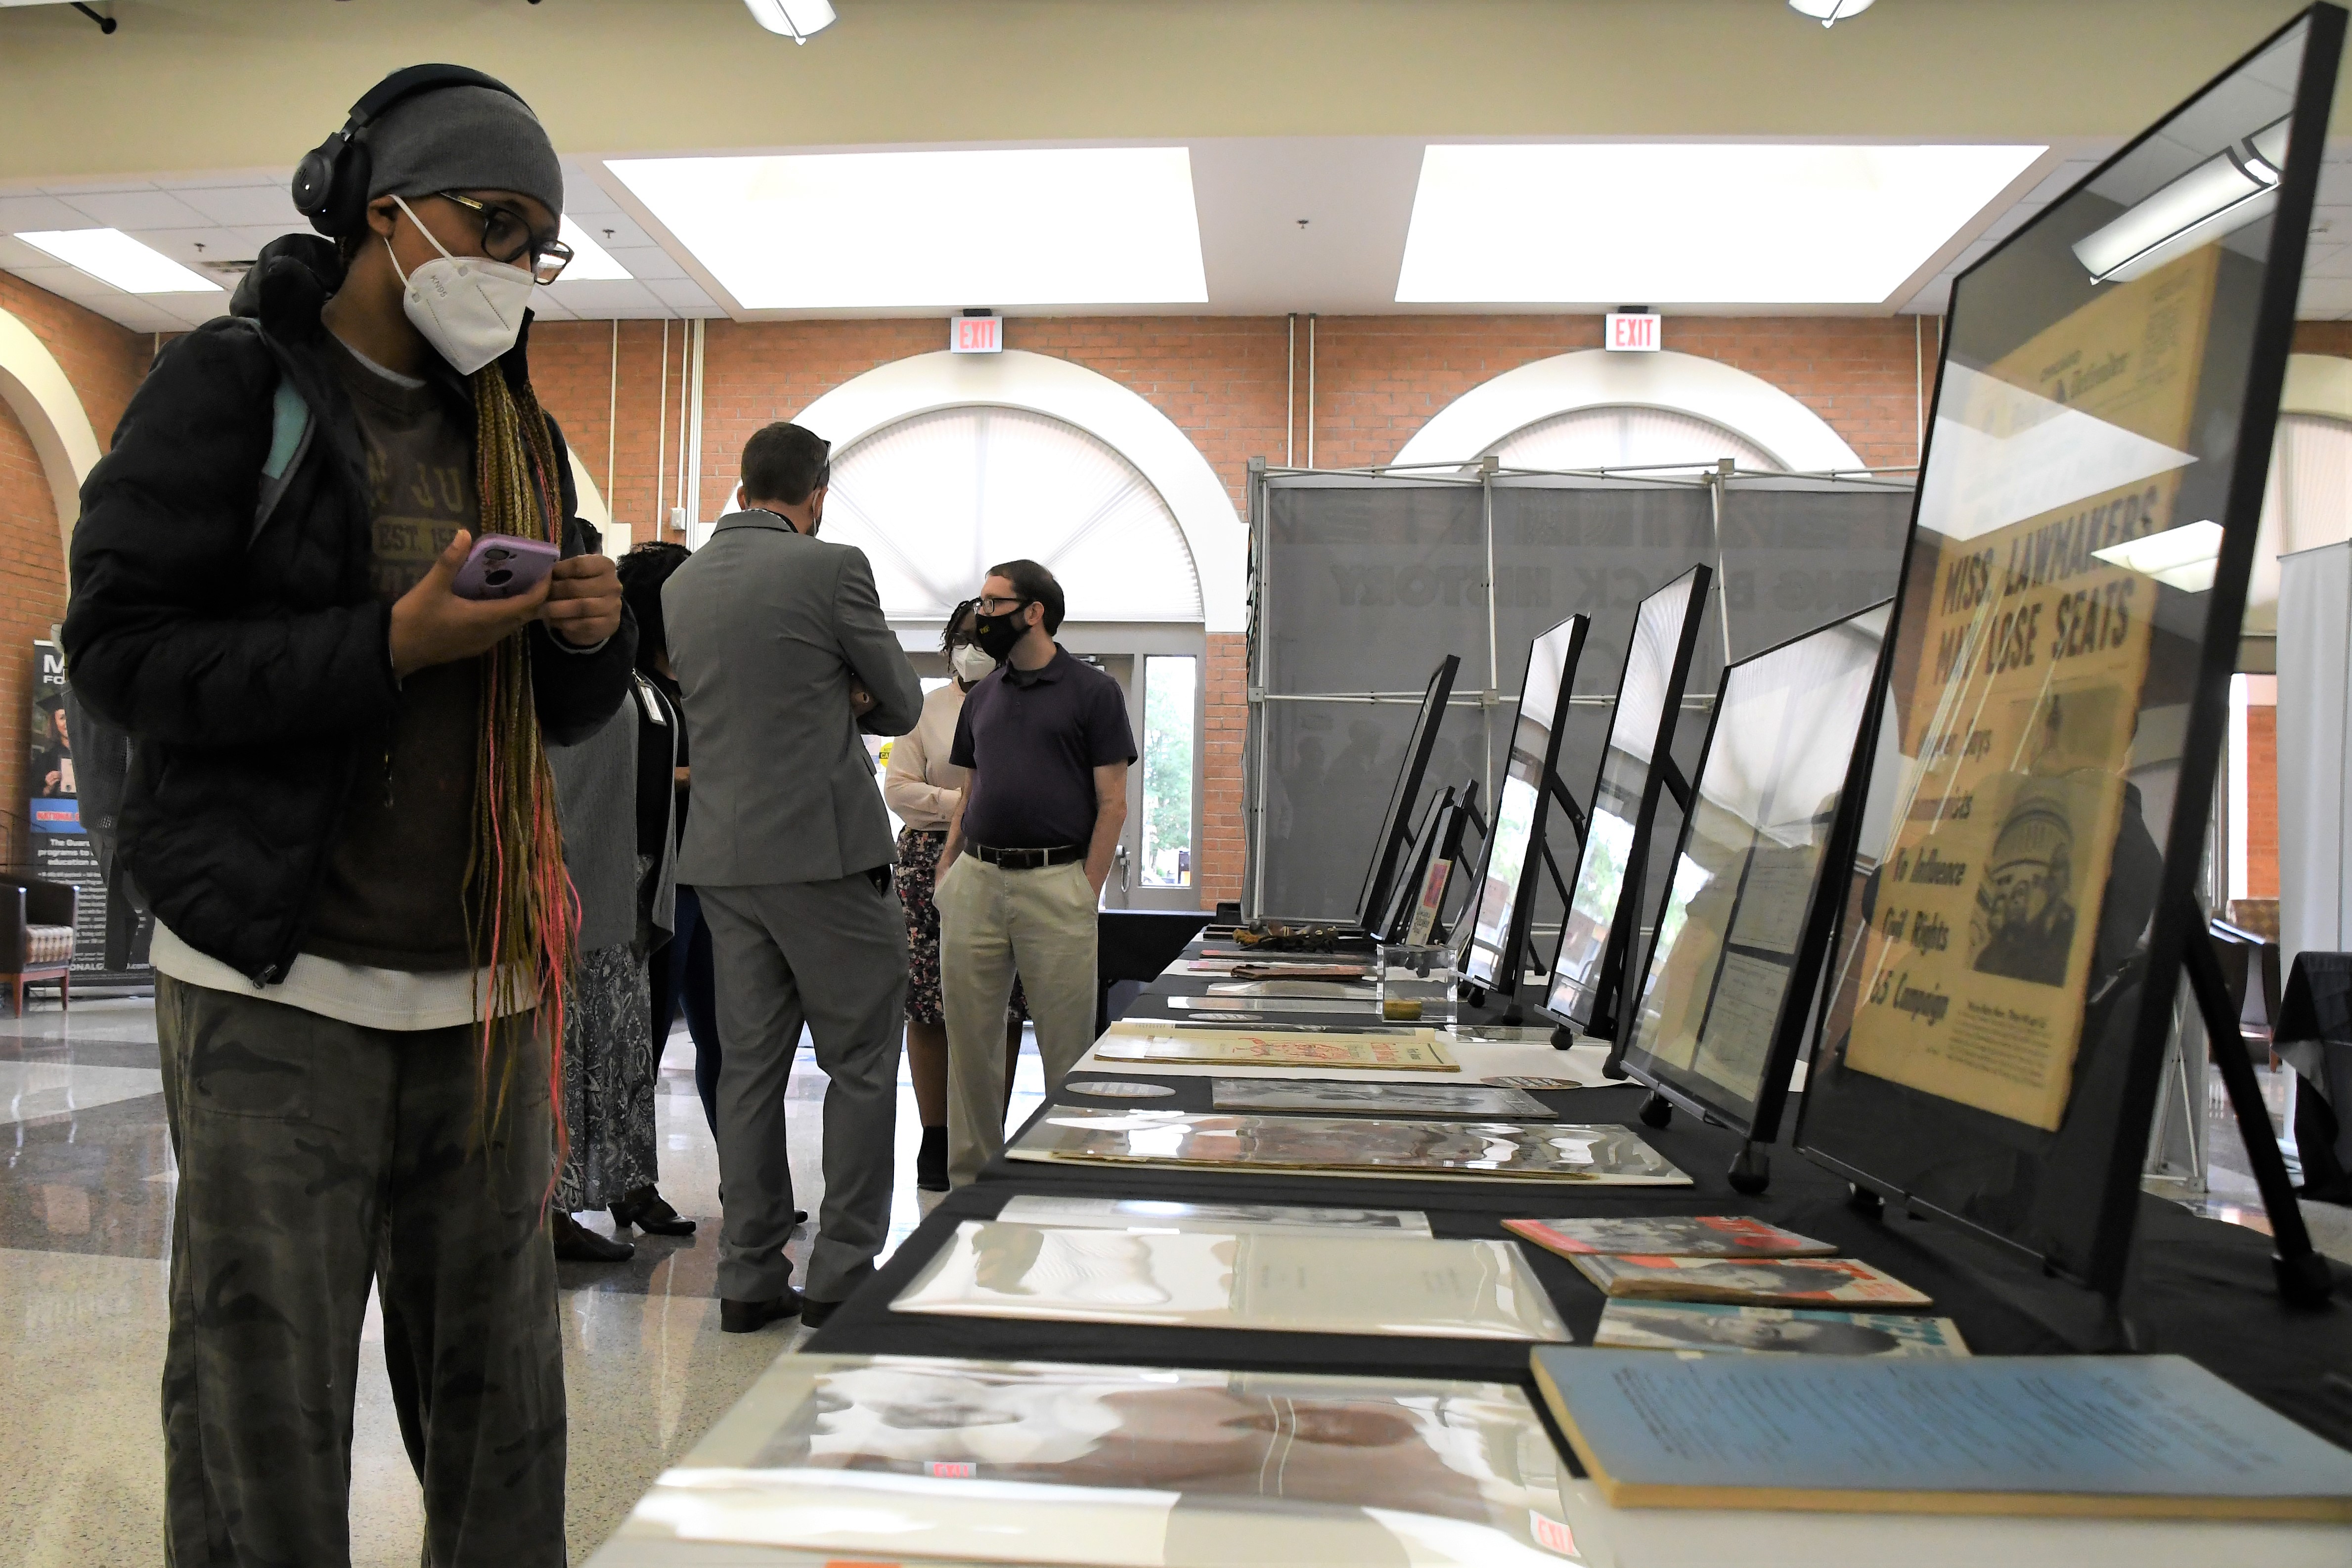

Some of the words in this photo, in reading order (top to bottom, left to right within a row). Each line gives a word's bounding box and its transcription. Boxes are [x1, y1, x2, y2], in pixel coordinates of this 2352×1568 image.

[430, 275, 447, 298] KN95
[959, 320, 997, 349] EXIT
[1616, 319, 1653, 346] EXIT
[1986, 603, 2043, 676] LOSE
[2051, 577, 2135, 661] SEATS
[43, 675, 65, 684] FO
[1910, 846, 1966, 886] Influence
[1882, 907, 1909, 943] Civil
[1911, 910, 1950, 956] Rights
[1893, 972, 1950, 1027] Campaign
